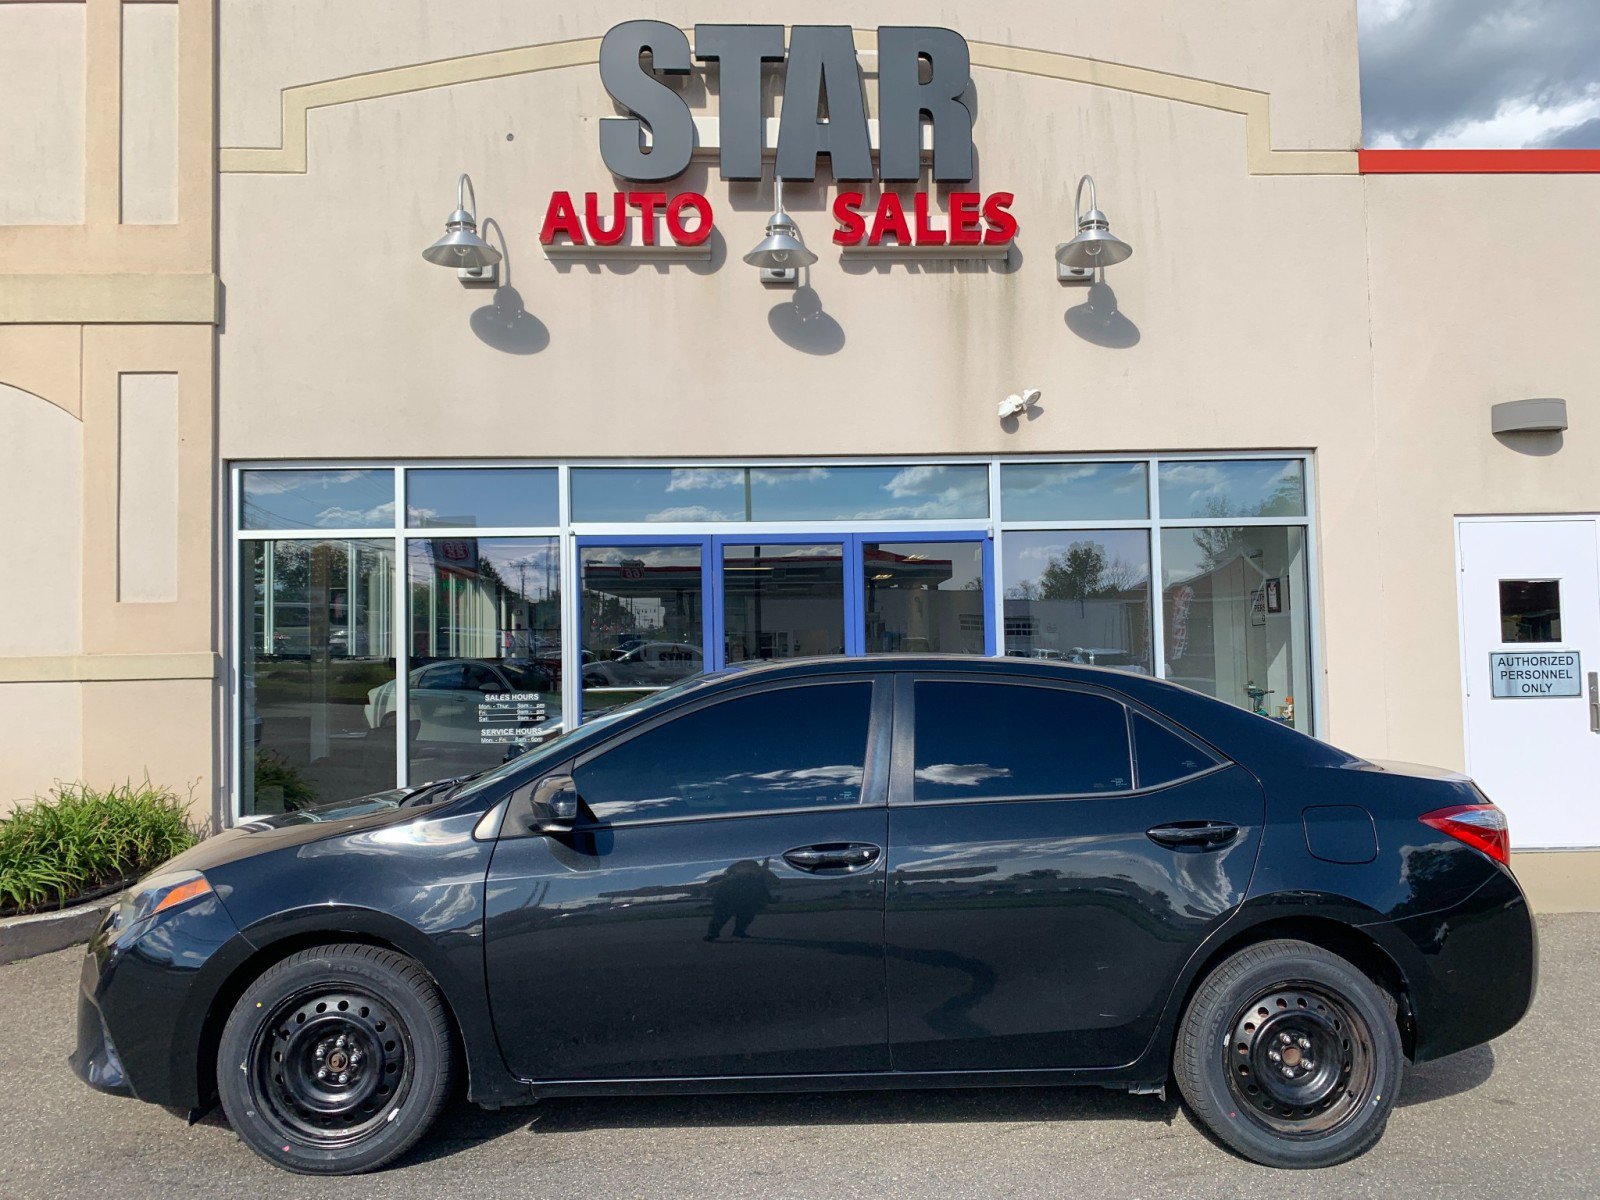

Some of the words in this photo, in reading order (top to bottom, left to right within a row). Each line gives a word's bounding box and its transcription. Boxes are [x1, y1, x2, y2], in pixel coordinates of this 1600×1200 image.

[599, 19, 973, 183] STAR
[539, 190, 713, 247] AUTO
[832, 191, 1017, 247] SALES
[1498, 656, 1574, 667] AUTHORIZED
[1500, 669, 1573, 680] PERSONNEL
[1522, 683, 1553, 693] ONLY
[511, 693, 539, 701] HOURS
[481, 728, 514, 736] SERVICE
